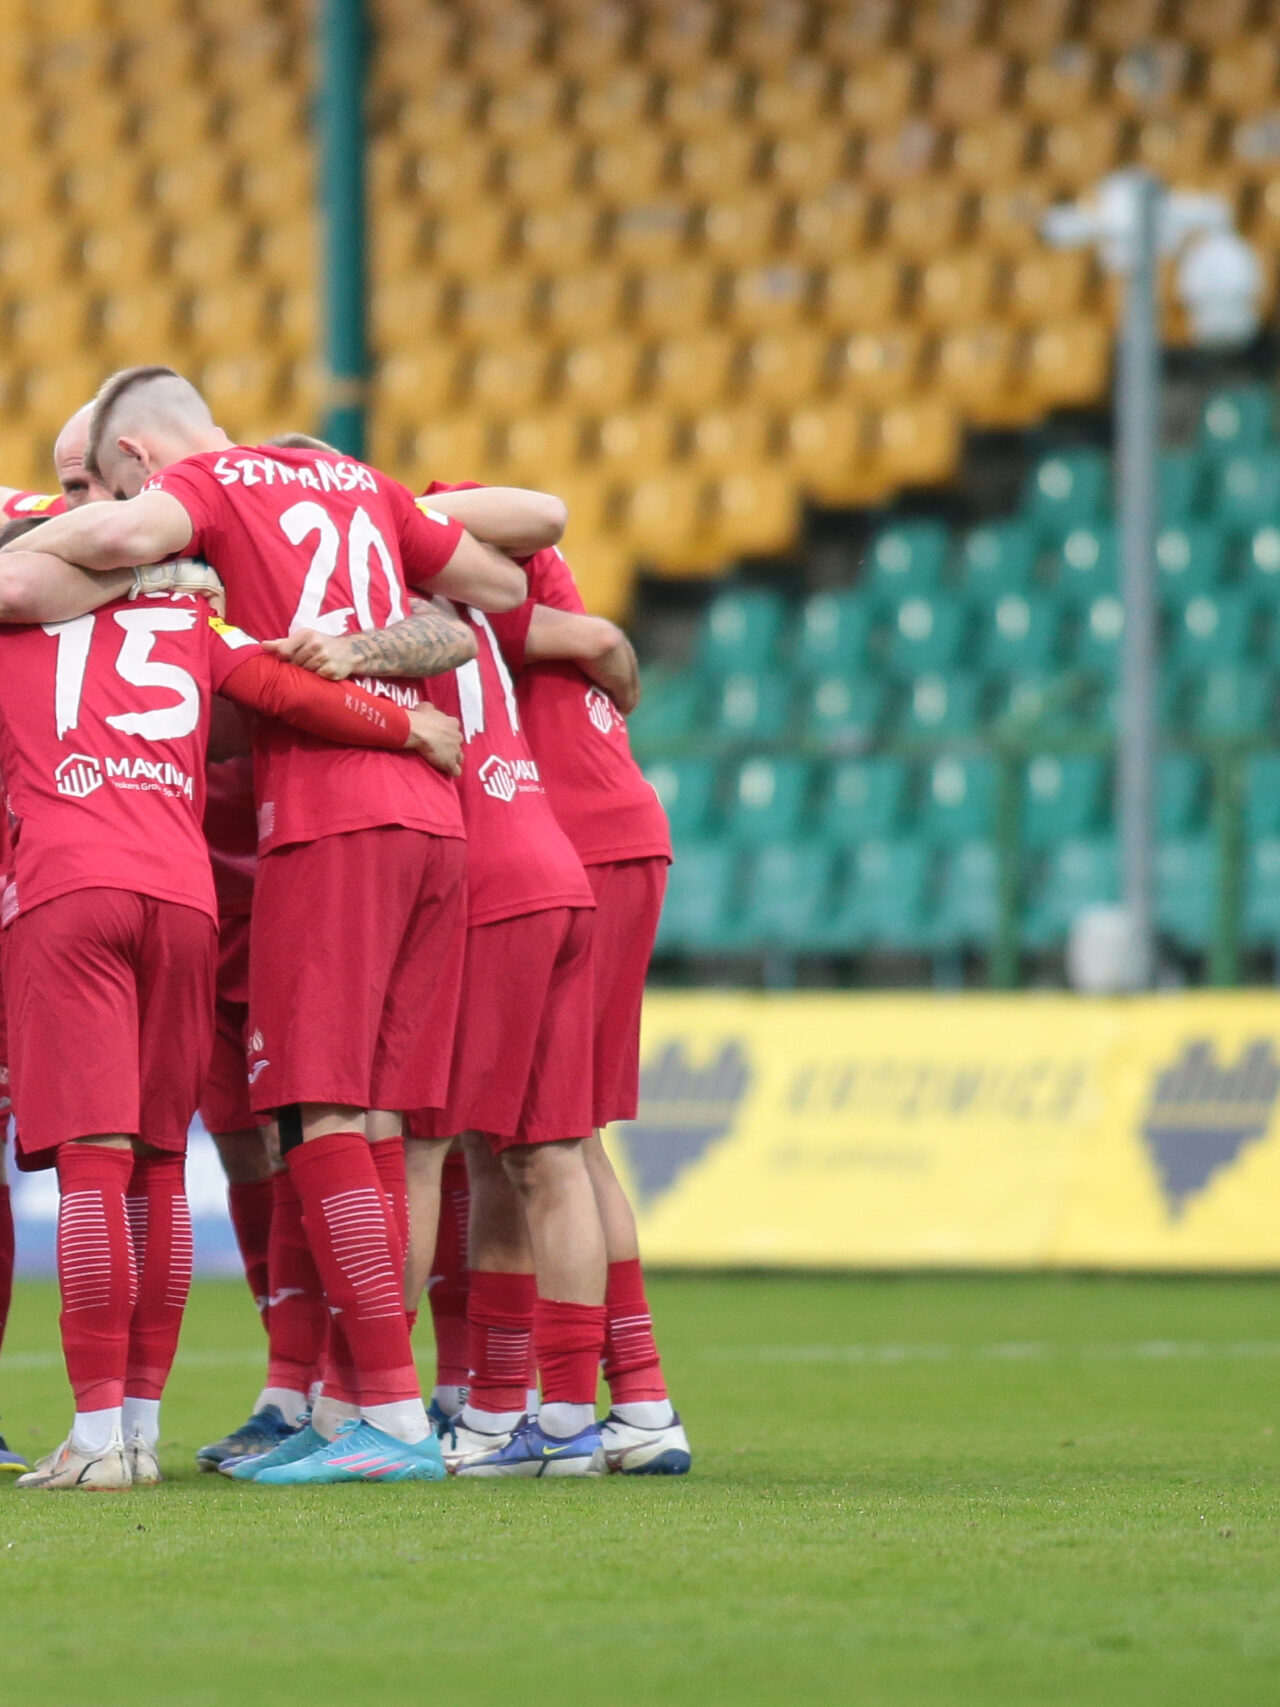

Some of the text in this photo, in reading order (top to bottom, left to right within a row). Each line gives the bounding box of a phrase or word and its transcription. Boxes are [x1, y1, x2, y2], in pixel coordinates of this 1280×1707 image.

[279, 501, 407, 637] 20
[41, 607, 200, 741] 15
[344, 693, 386, 729] KIPSTA
[105, 757, 193, 800] MAXIMA
